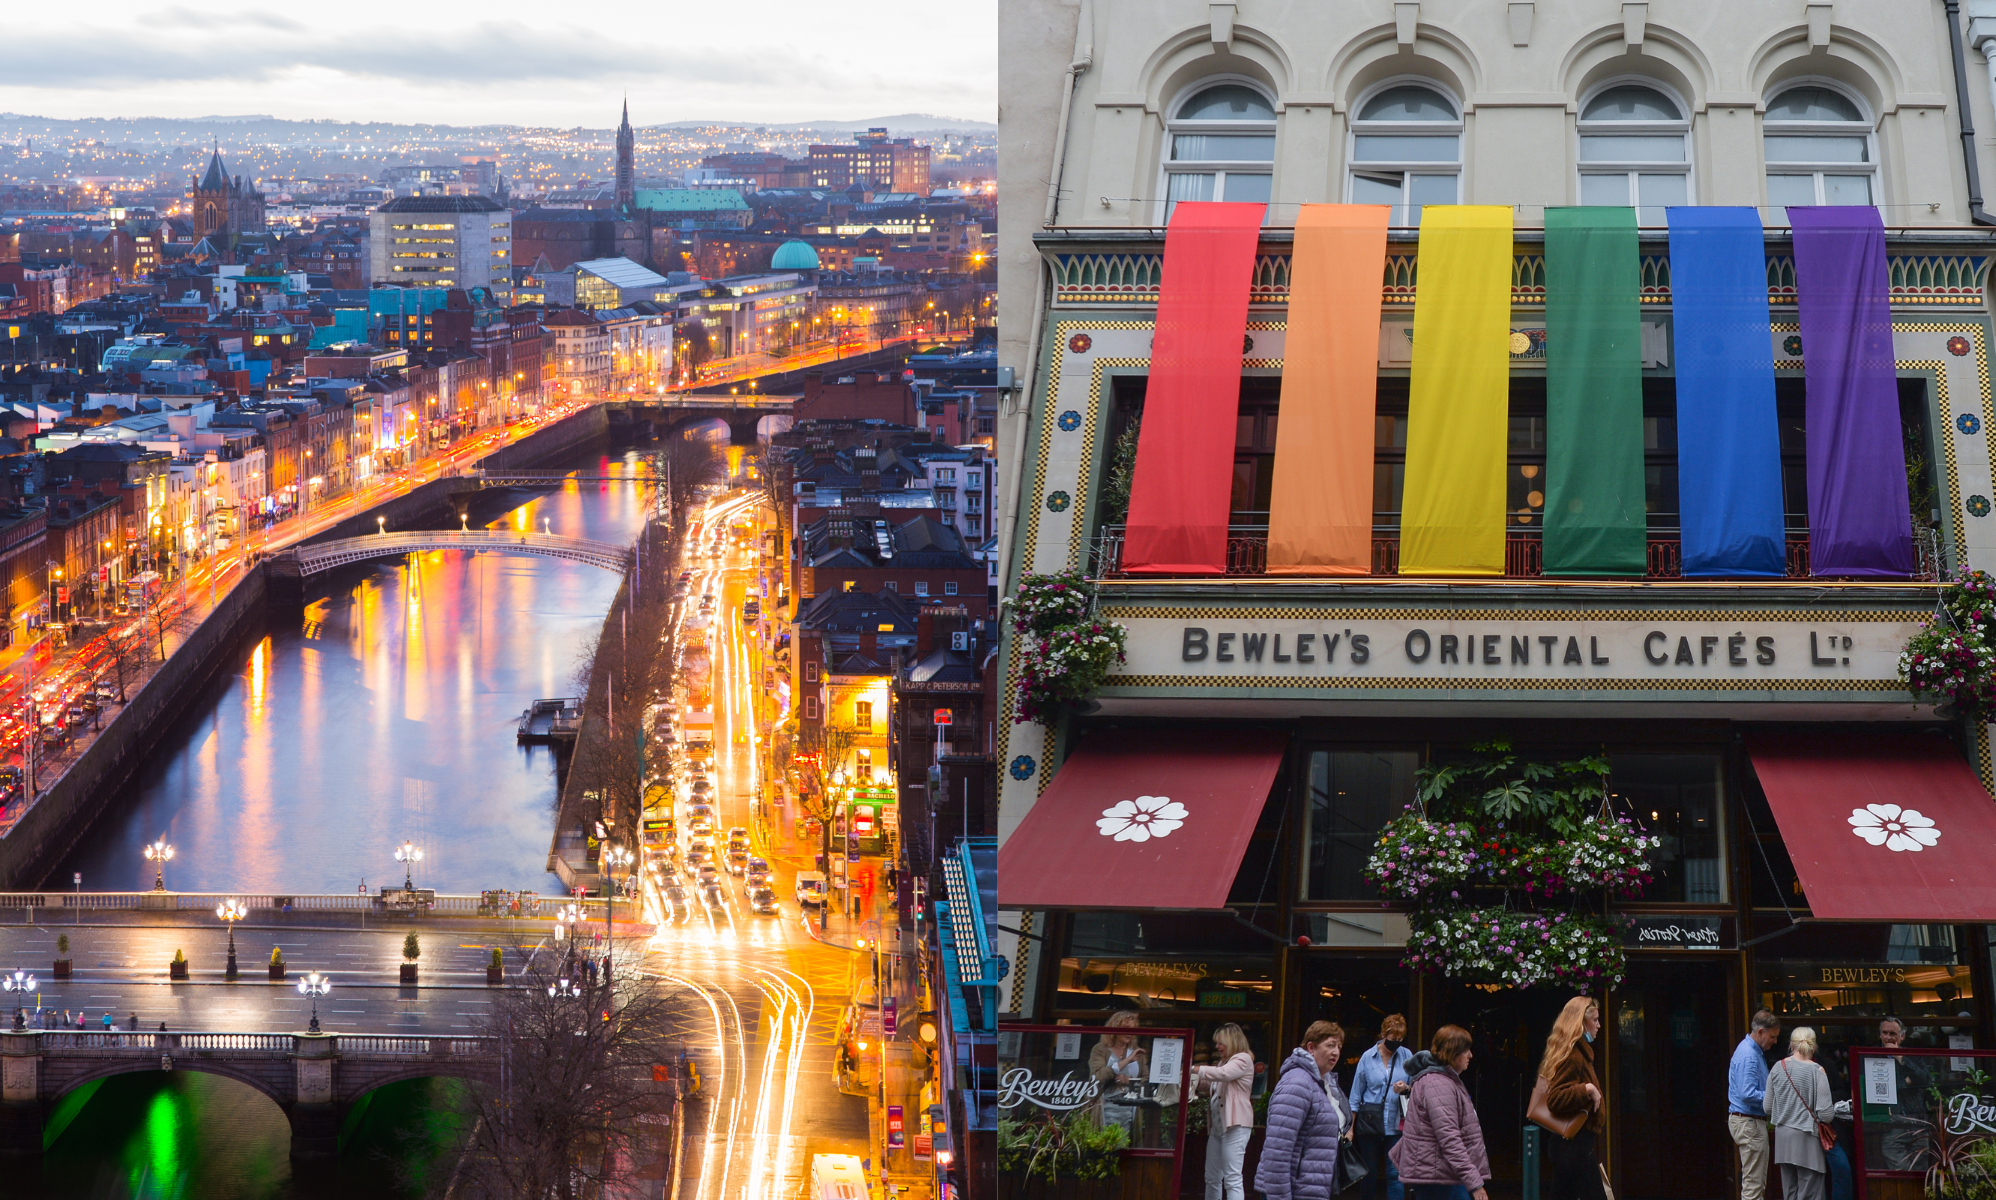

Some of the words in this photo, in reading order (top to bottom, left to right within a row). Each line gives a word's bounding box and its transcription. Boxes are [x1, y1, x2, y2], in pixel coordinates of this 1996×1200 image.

[1182, 627, 1370, 663] BEWLEY'S
[1405, 629, 1610, 664] ORIENTAL
[1643, 630, 1776, 664] CAFÉS
[905, 682, 926, 690] KAPP
[933, 682, 968, 690] PETERSON
[1124, 962, 1208, 977] BEWLEY'S
[1821, 968, 1905, 983] BEWLEY'S
[1204, 994, 1241, 1005] BREAD
[998, 1067, 1100, 1109] Bewley's
[1051, 1096, 1072, 1105] 1840
